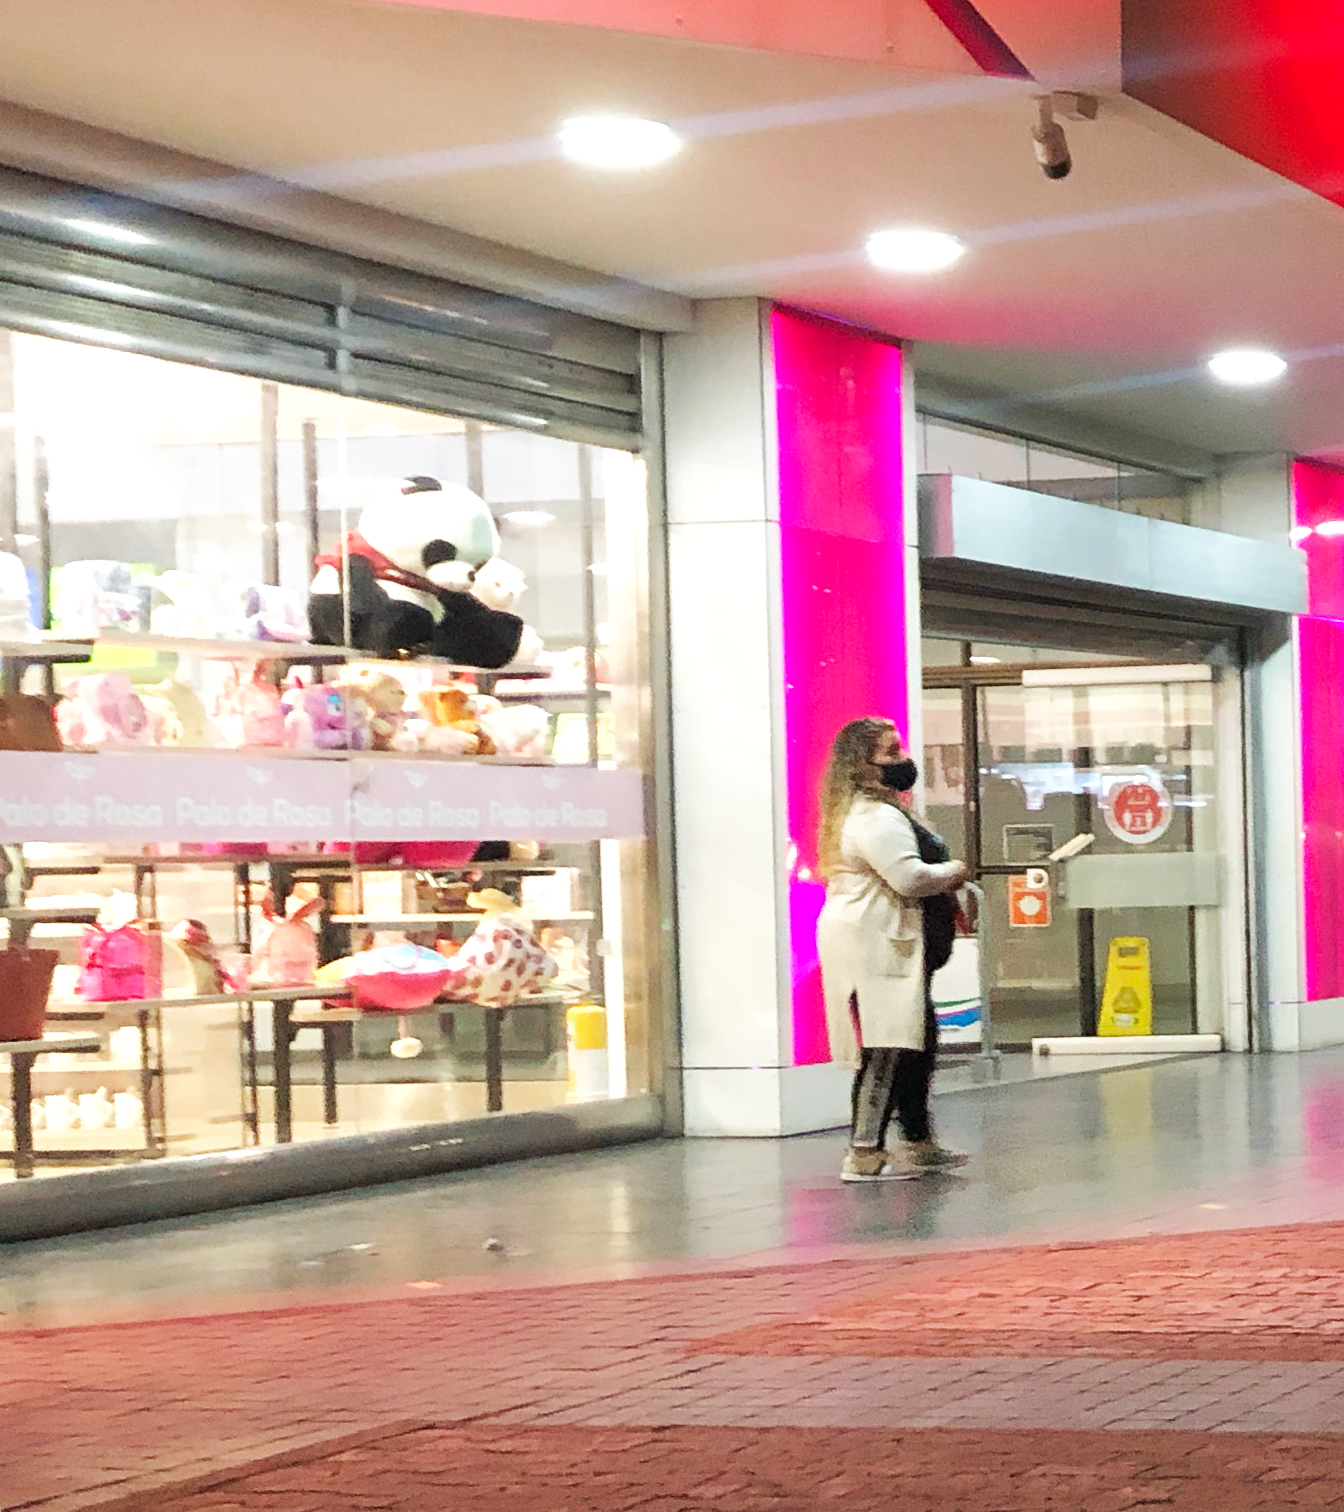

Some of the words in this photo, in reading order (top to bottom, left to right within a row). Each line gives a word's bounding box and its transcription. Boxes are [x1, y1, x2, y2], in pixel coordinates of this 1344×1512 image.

[52, 795, 89, 827] de
[94, 794, 164, 827] Rosa
[174, 796, 232, 827] Palo
[236, 796, 269, 827] de
[272, 797, 333, 827] Rosa
[343, 799, 393, 827] Palo
[397, 800, 423, 827] de
[428, 800, 480, 827] Rosa
[489, 799, 531, 827] Palo
[534, 801, 558, 827] de
[560, 800, 608, 828] Rosa
